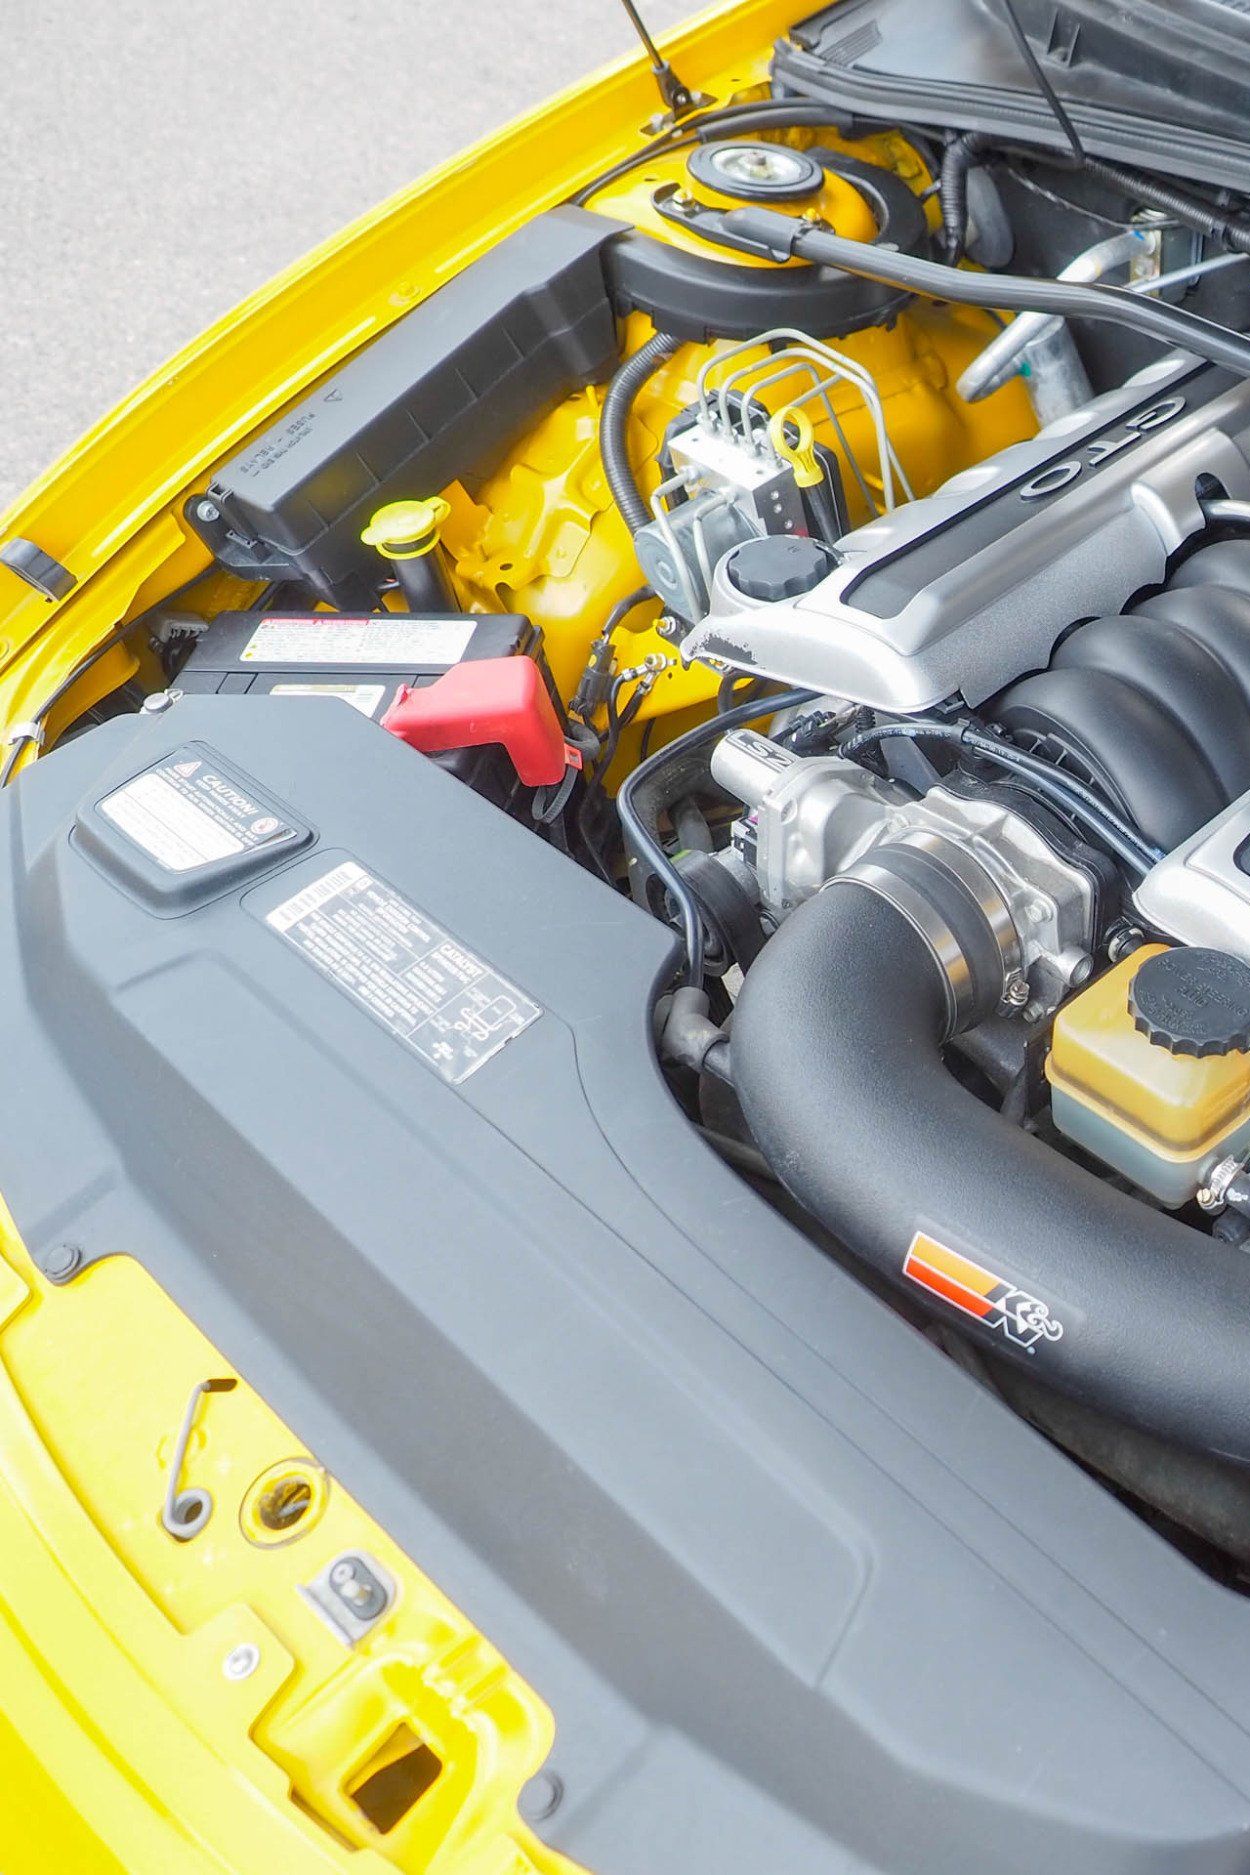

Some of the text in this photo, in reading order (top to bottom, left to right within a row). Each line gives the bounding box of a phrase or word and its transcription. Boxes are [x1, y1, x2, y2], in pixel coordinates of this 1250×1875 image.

[1019, 396, 1187, 501] GTO
[726, 731, 797, 771] LS2
[201, 773, 260, 816] CAUTION!
[984, 1282, 1064, 1349] K&N
